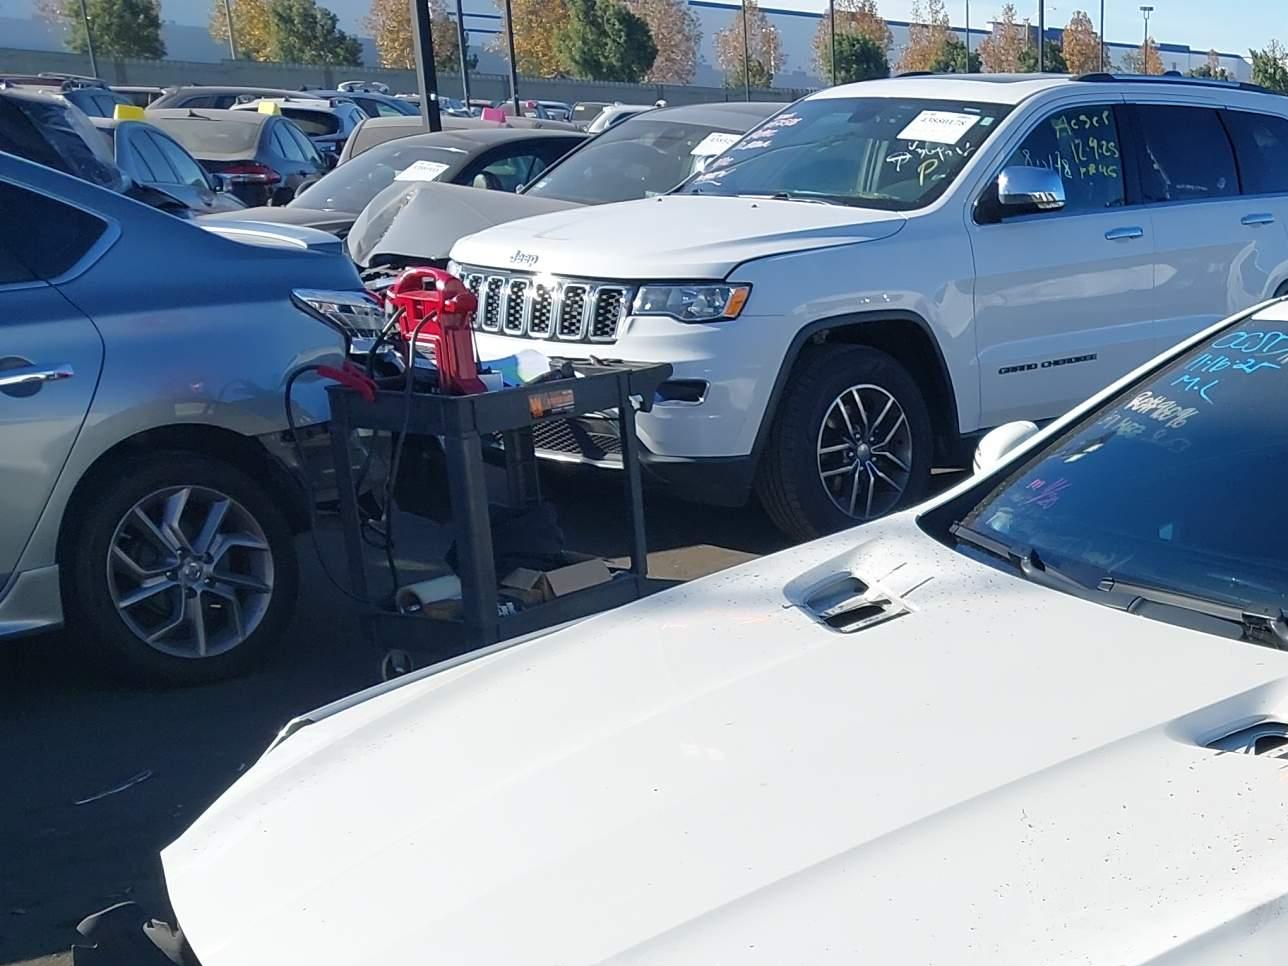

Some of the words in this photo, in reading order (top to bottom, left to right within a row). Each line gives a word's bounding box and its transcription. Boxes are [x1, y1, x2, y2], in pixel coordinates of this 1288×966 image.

[510, 250, 539, 267] Jeep
[998, 363, 1038, 375] GRAND
[1041, 353, 1098, 369] CHEROKEE
